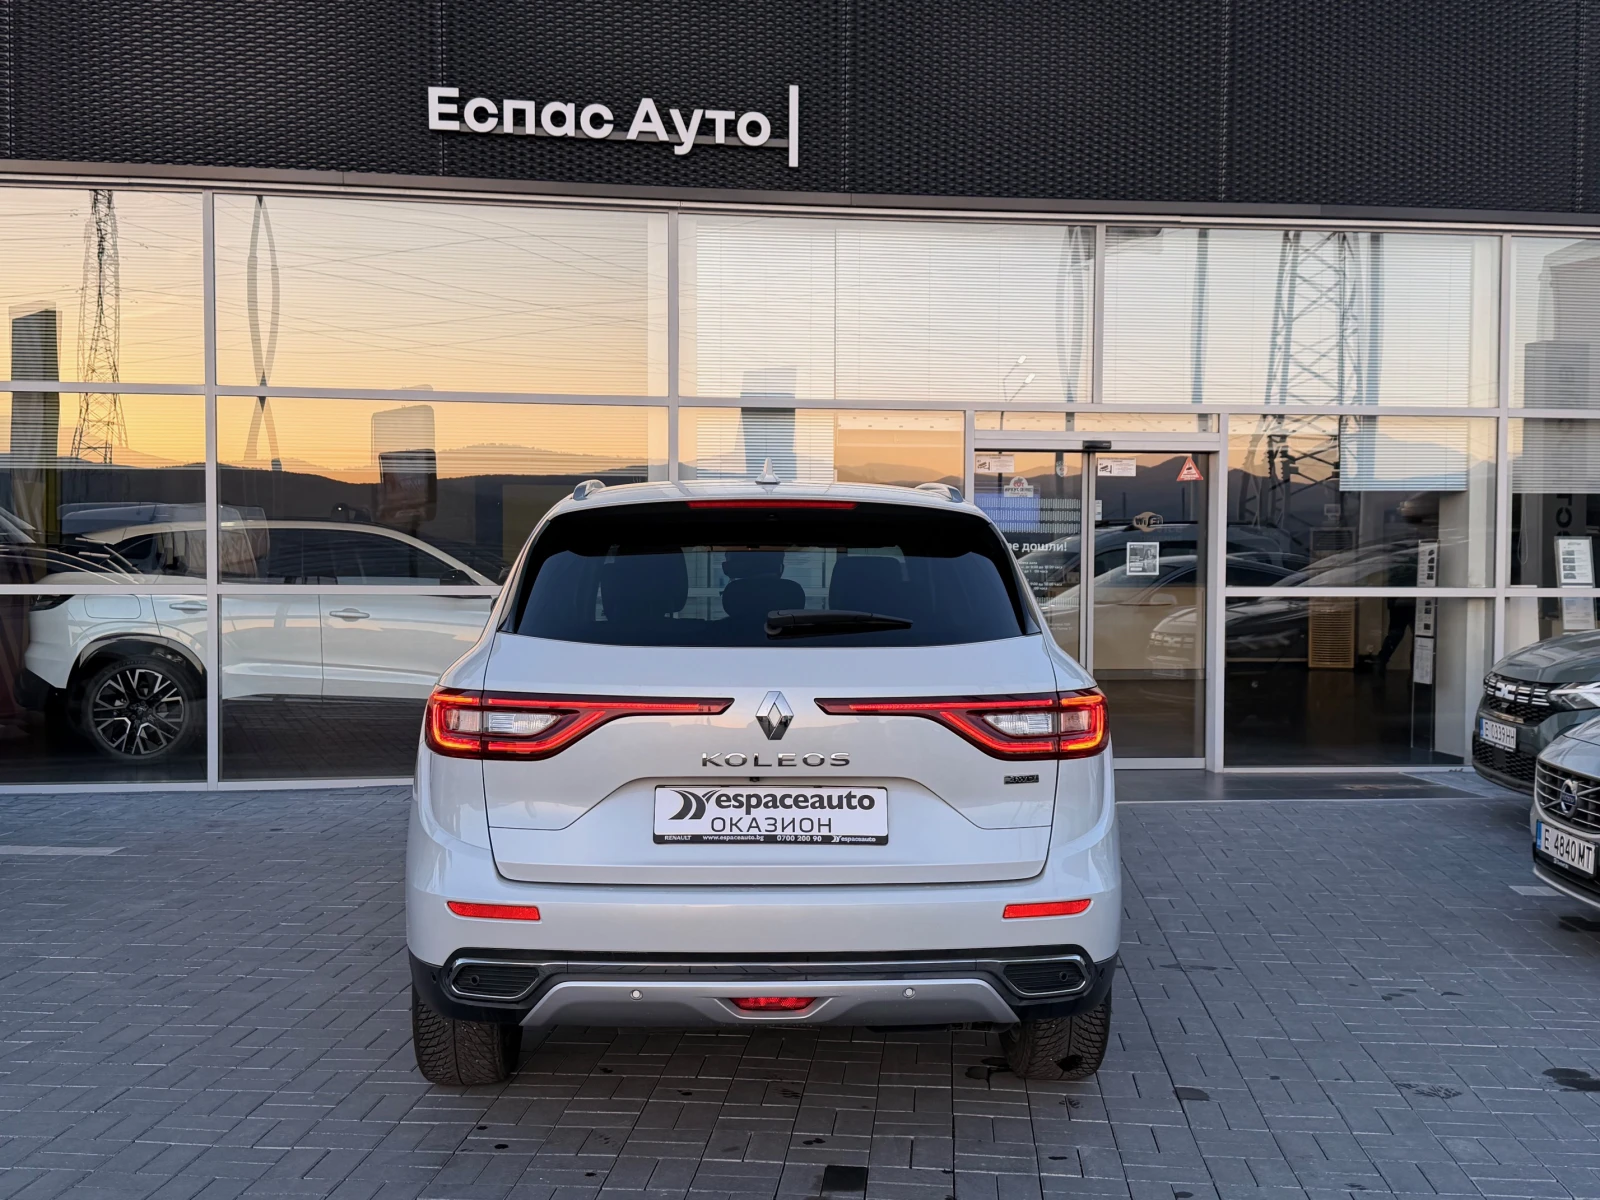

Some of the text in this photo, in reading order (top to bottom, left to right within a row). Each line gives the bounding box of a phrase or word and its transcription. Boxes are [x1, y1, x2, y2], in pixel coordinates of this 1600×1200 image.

[427, 86, 771, 156] Еспас Ауто
[1022, 542, 1067, 552] дошли!
[701, 752, 851, 768] KOLEOS
[715, 790, 876, 816] espaceauto
[710, 816, 832, 834] ОКАЗИОН
[702, 834, 765, 842] www.espaceauto.bg
[776, 834, 797, 842] 0700
[798, 834, 811, 842] 200
